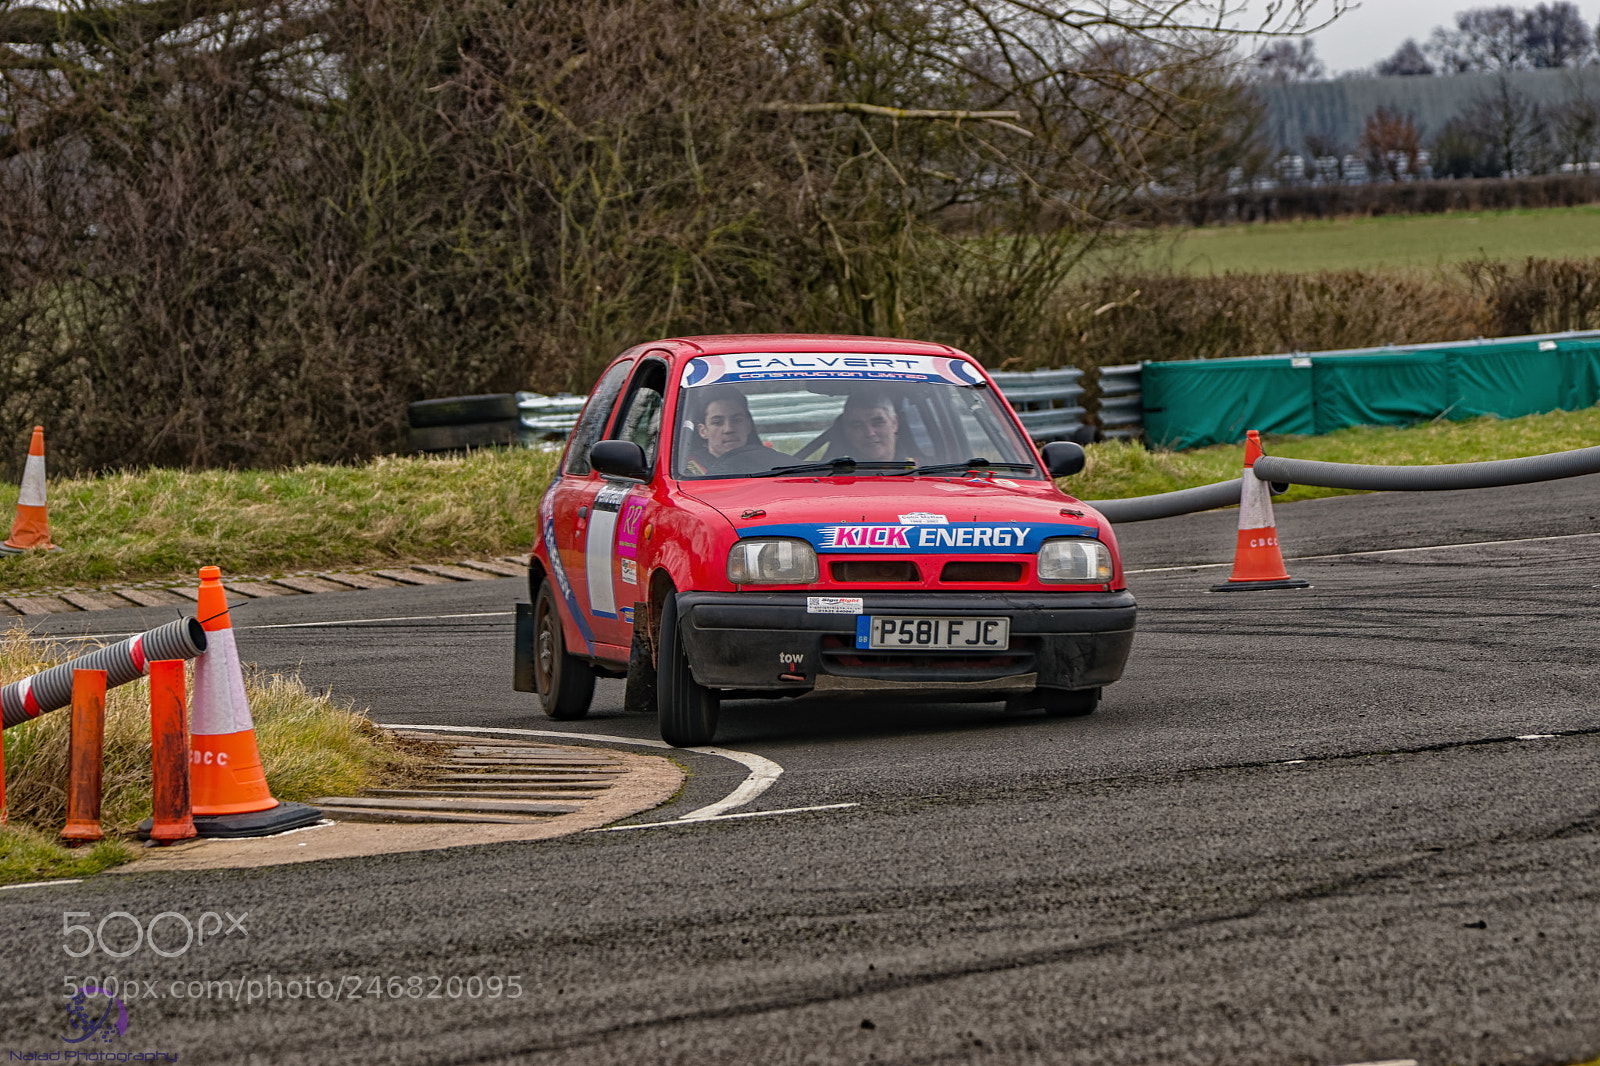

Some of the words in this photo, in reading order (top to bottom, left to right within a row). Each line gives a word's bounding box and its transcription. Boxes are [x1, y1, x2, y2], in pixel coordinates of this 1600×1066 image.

[736, 357, 920, 370] CALVERT
[739, 371, 863, 379] CONSTRUCTION
[866, 371, 928, 380] LIMITED
[832, 526, 913, 548] KICK
[918, 527, 1031, 547] ENERGY
[879, 619, 940, 645] P581
[947, 620, 1000, 646] FJC
[779, 652, 804, 664] tow
